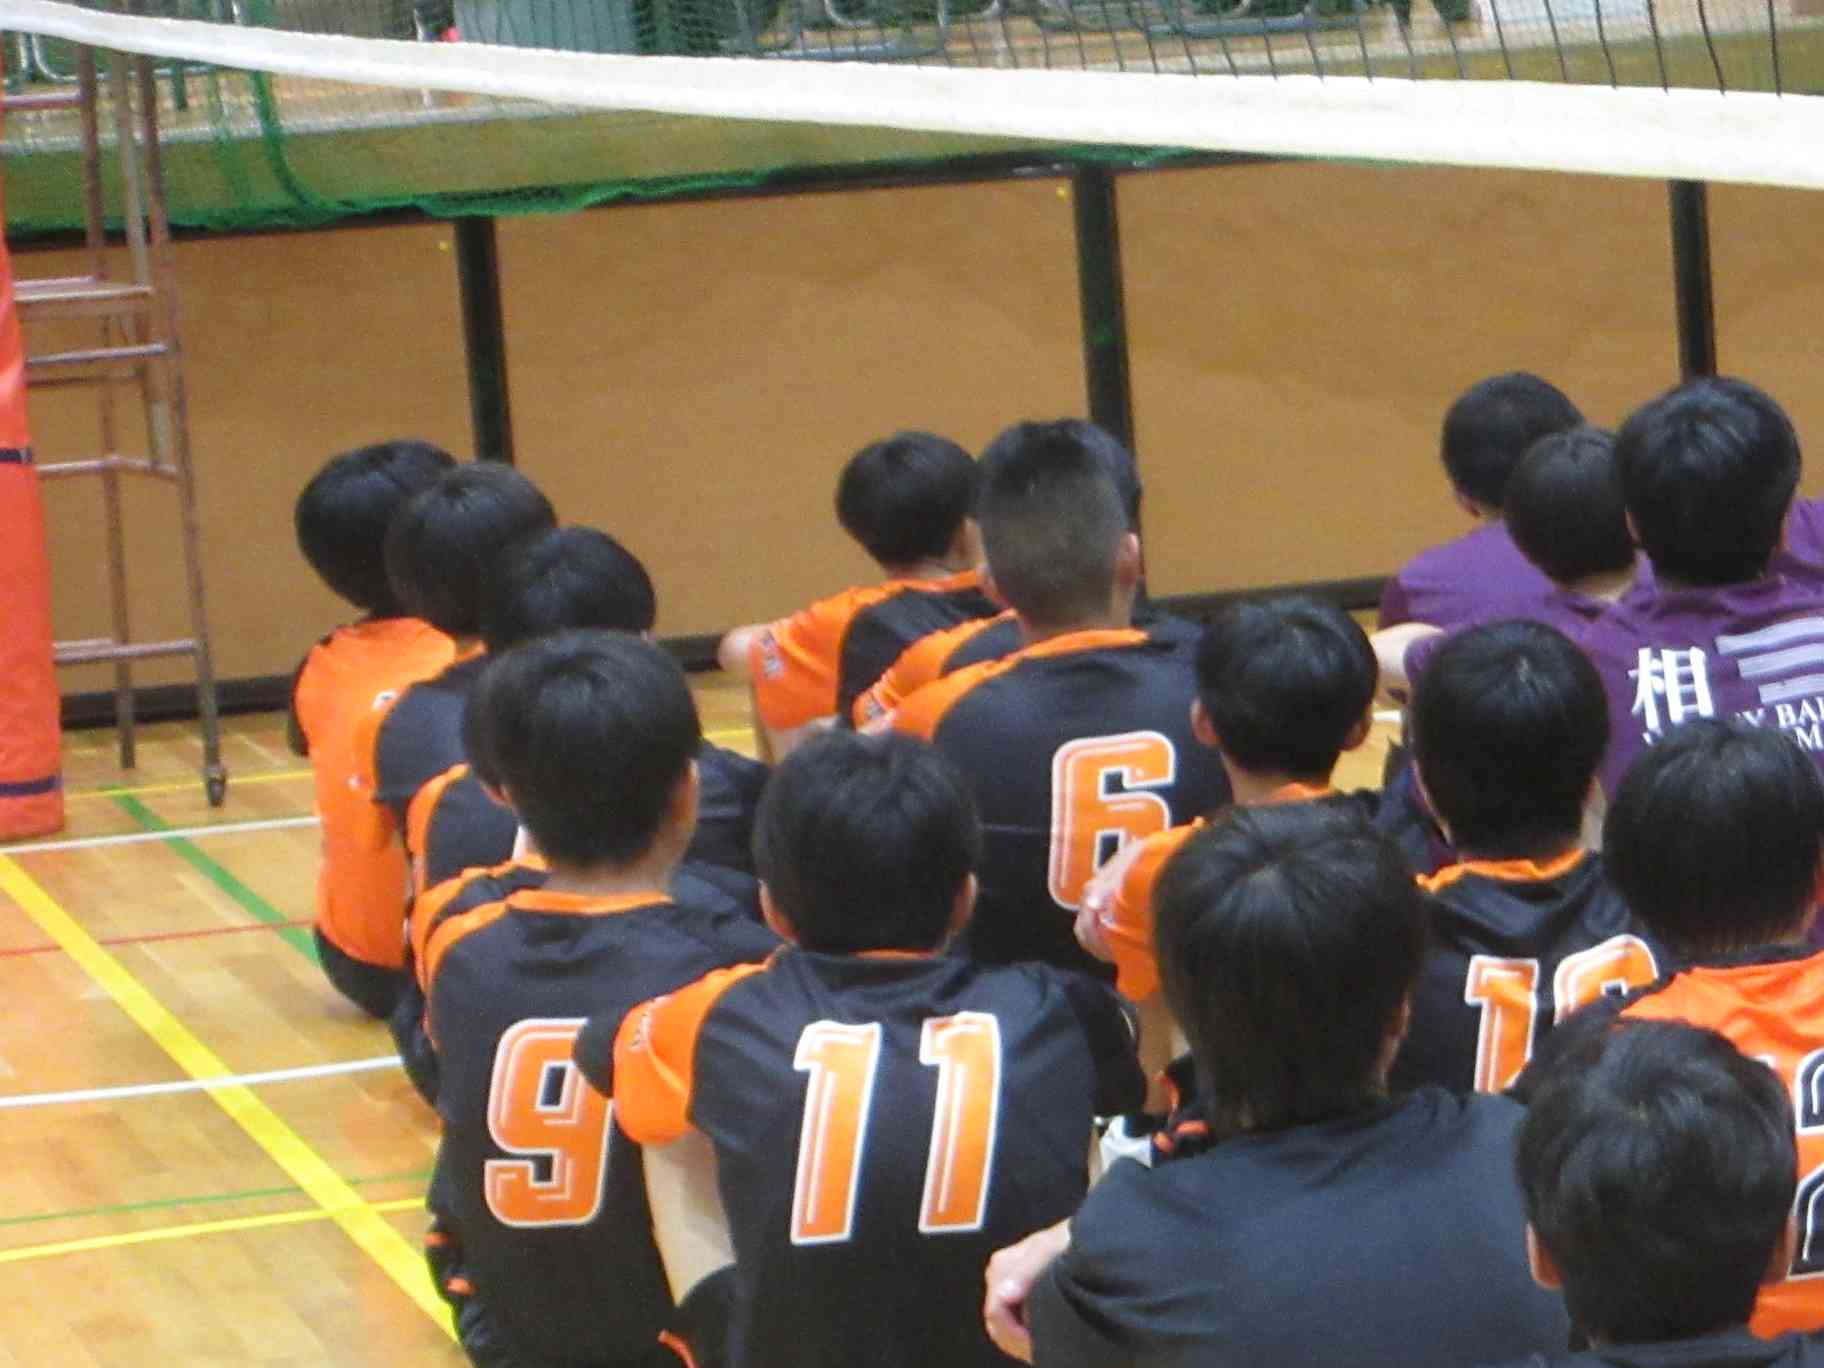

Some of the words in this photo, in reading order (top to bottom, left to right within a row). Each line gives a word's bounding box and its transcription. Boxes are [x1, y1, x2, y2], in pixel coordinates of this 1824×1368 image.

[1627, 646, 1715, 736] 相
[1048, 730, 1175, 912] 6
[484, 1018, 614, 1229] 9
[790, 1010, 1000, 1246] 11
